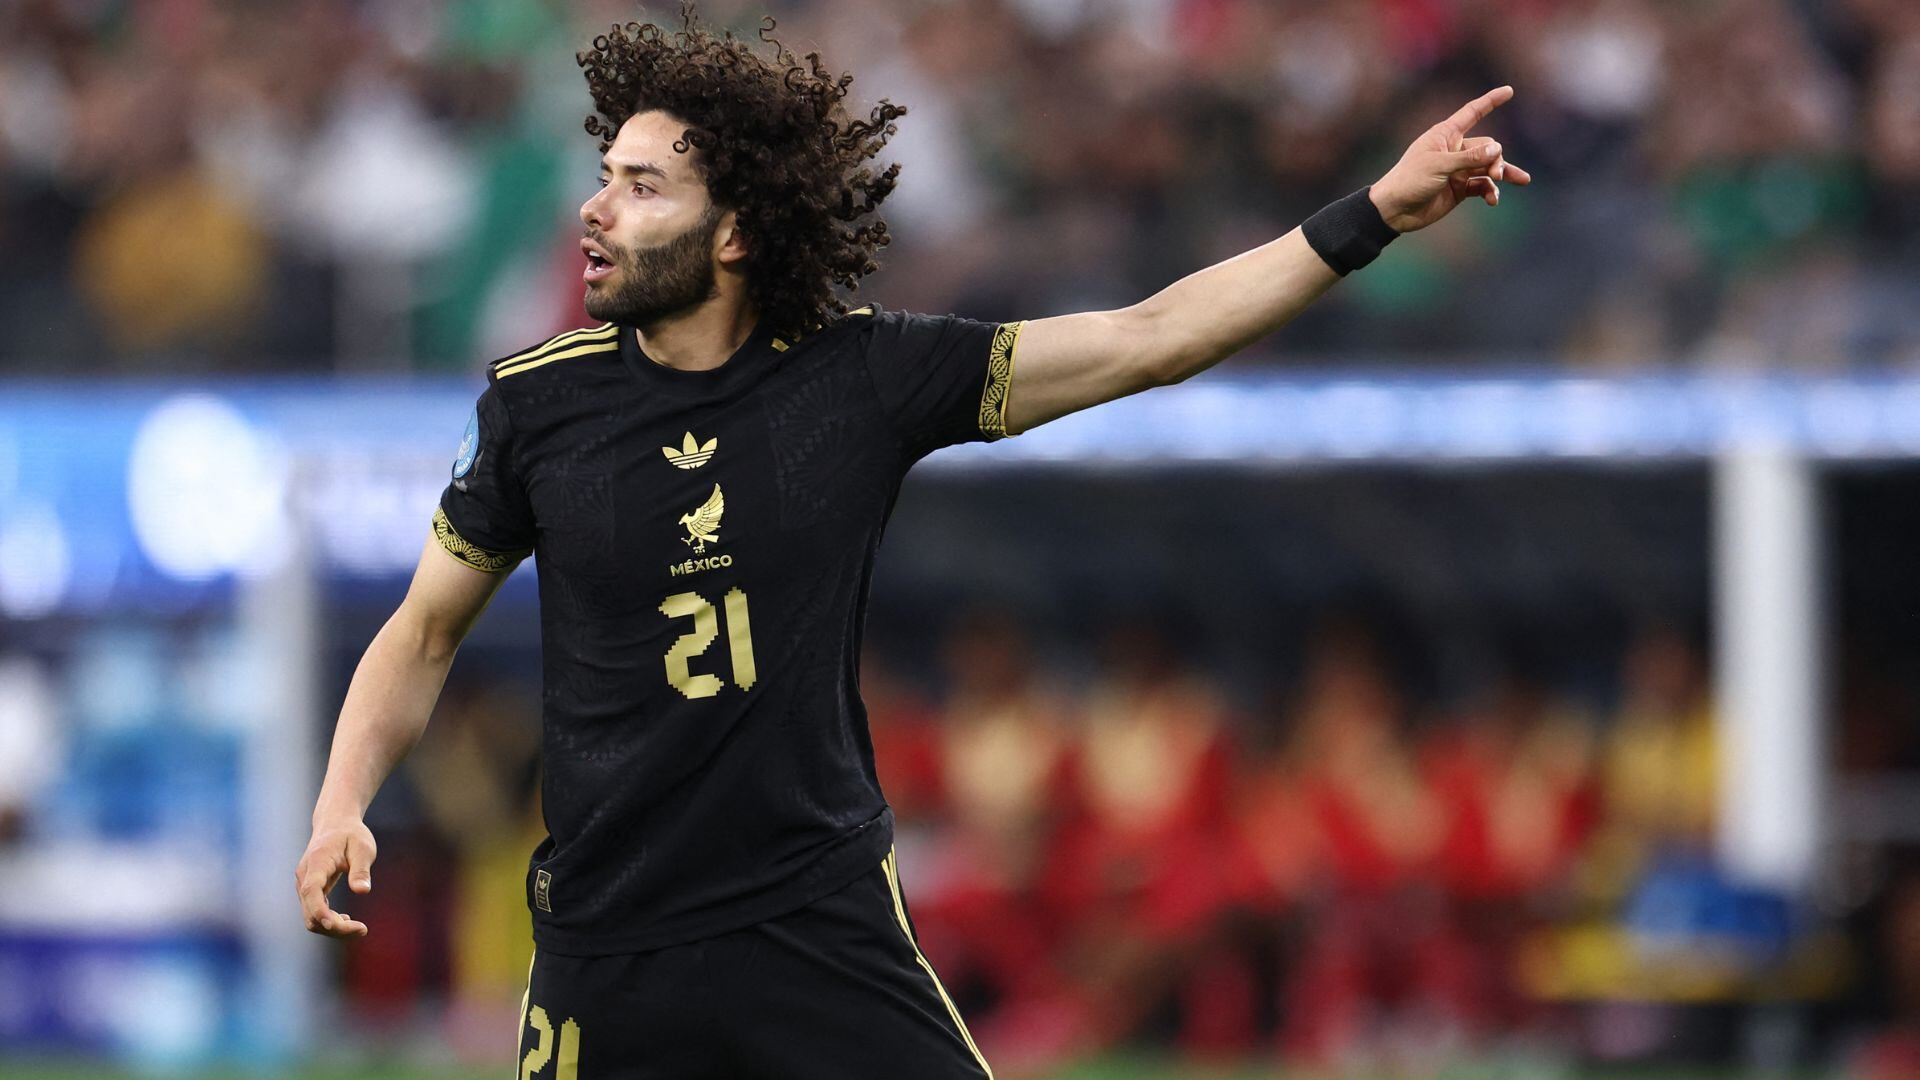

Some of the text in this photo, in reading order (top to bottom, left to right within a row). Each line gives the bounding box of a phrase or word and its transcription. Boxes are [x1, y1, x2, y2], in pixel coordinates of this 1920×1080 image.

[670, 554, 733, 577] MÉXICO
[658, 586, 757, 700] 21
[521, 1004, 581, 1080] 21
